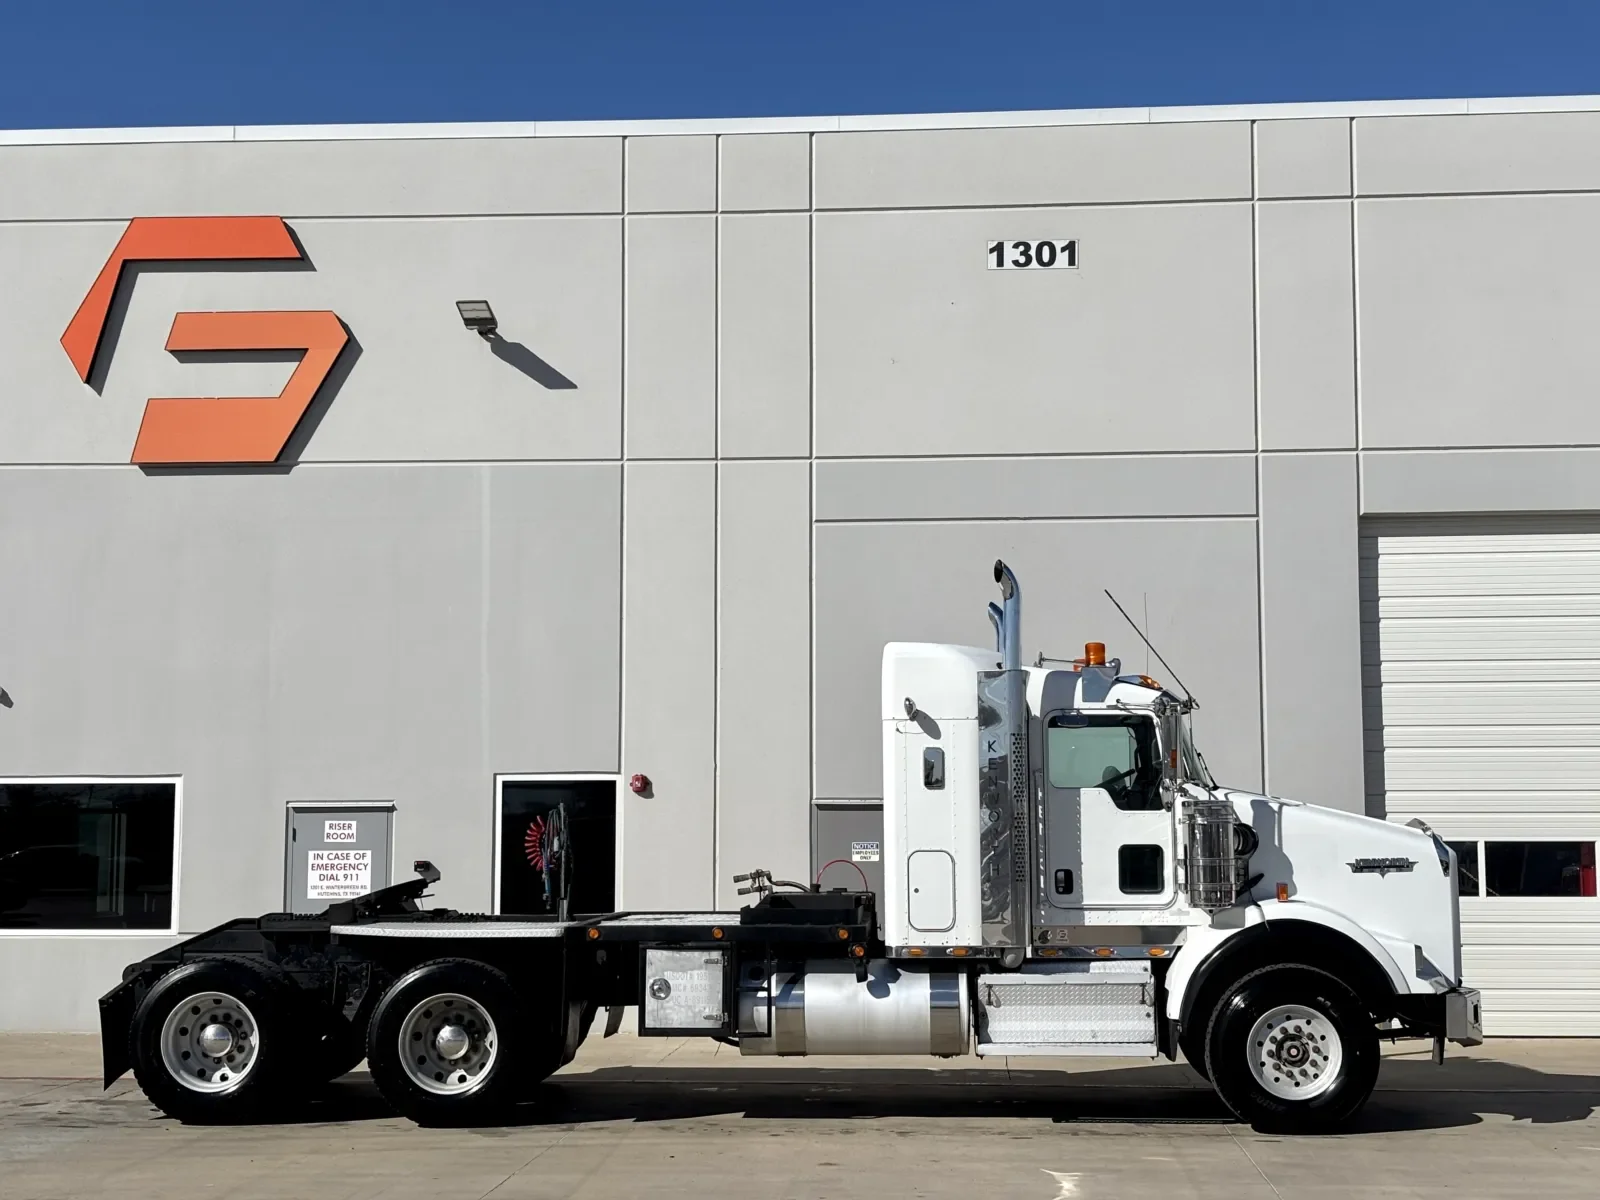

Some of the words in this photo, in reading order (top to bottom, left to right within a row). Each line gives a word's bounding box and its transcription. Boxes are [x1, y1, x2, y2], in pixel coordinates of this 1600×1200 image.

[989, 240, 1076, 268] 1301
[328, 823, 352, 831] RISER
[325, 832, 355, 840] ROOM
[313, 852, 324, 861] IN
[326, 852, 351, 861] CASE
[353, 852, 367, 861] OF
[311, 863, 369, 871] EMERGENCY
[318, 873, 340, 882] DIAL
[343, 873, 359, 882] 911
